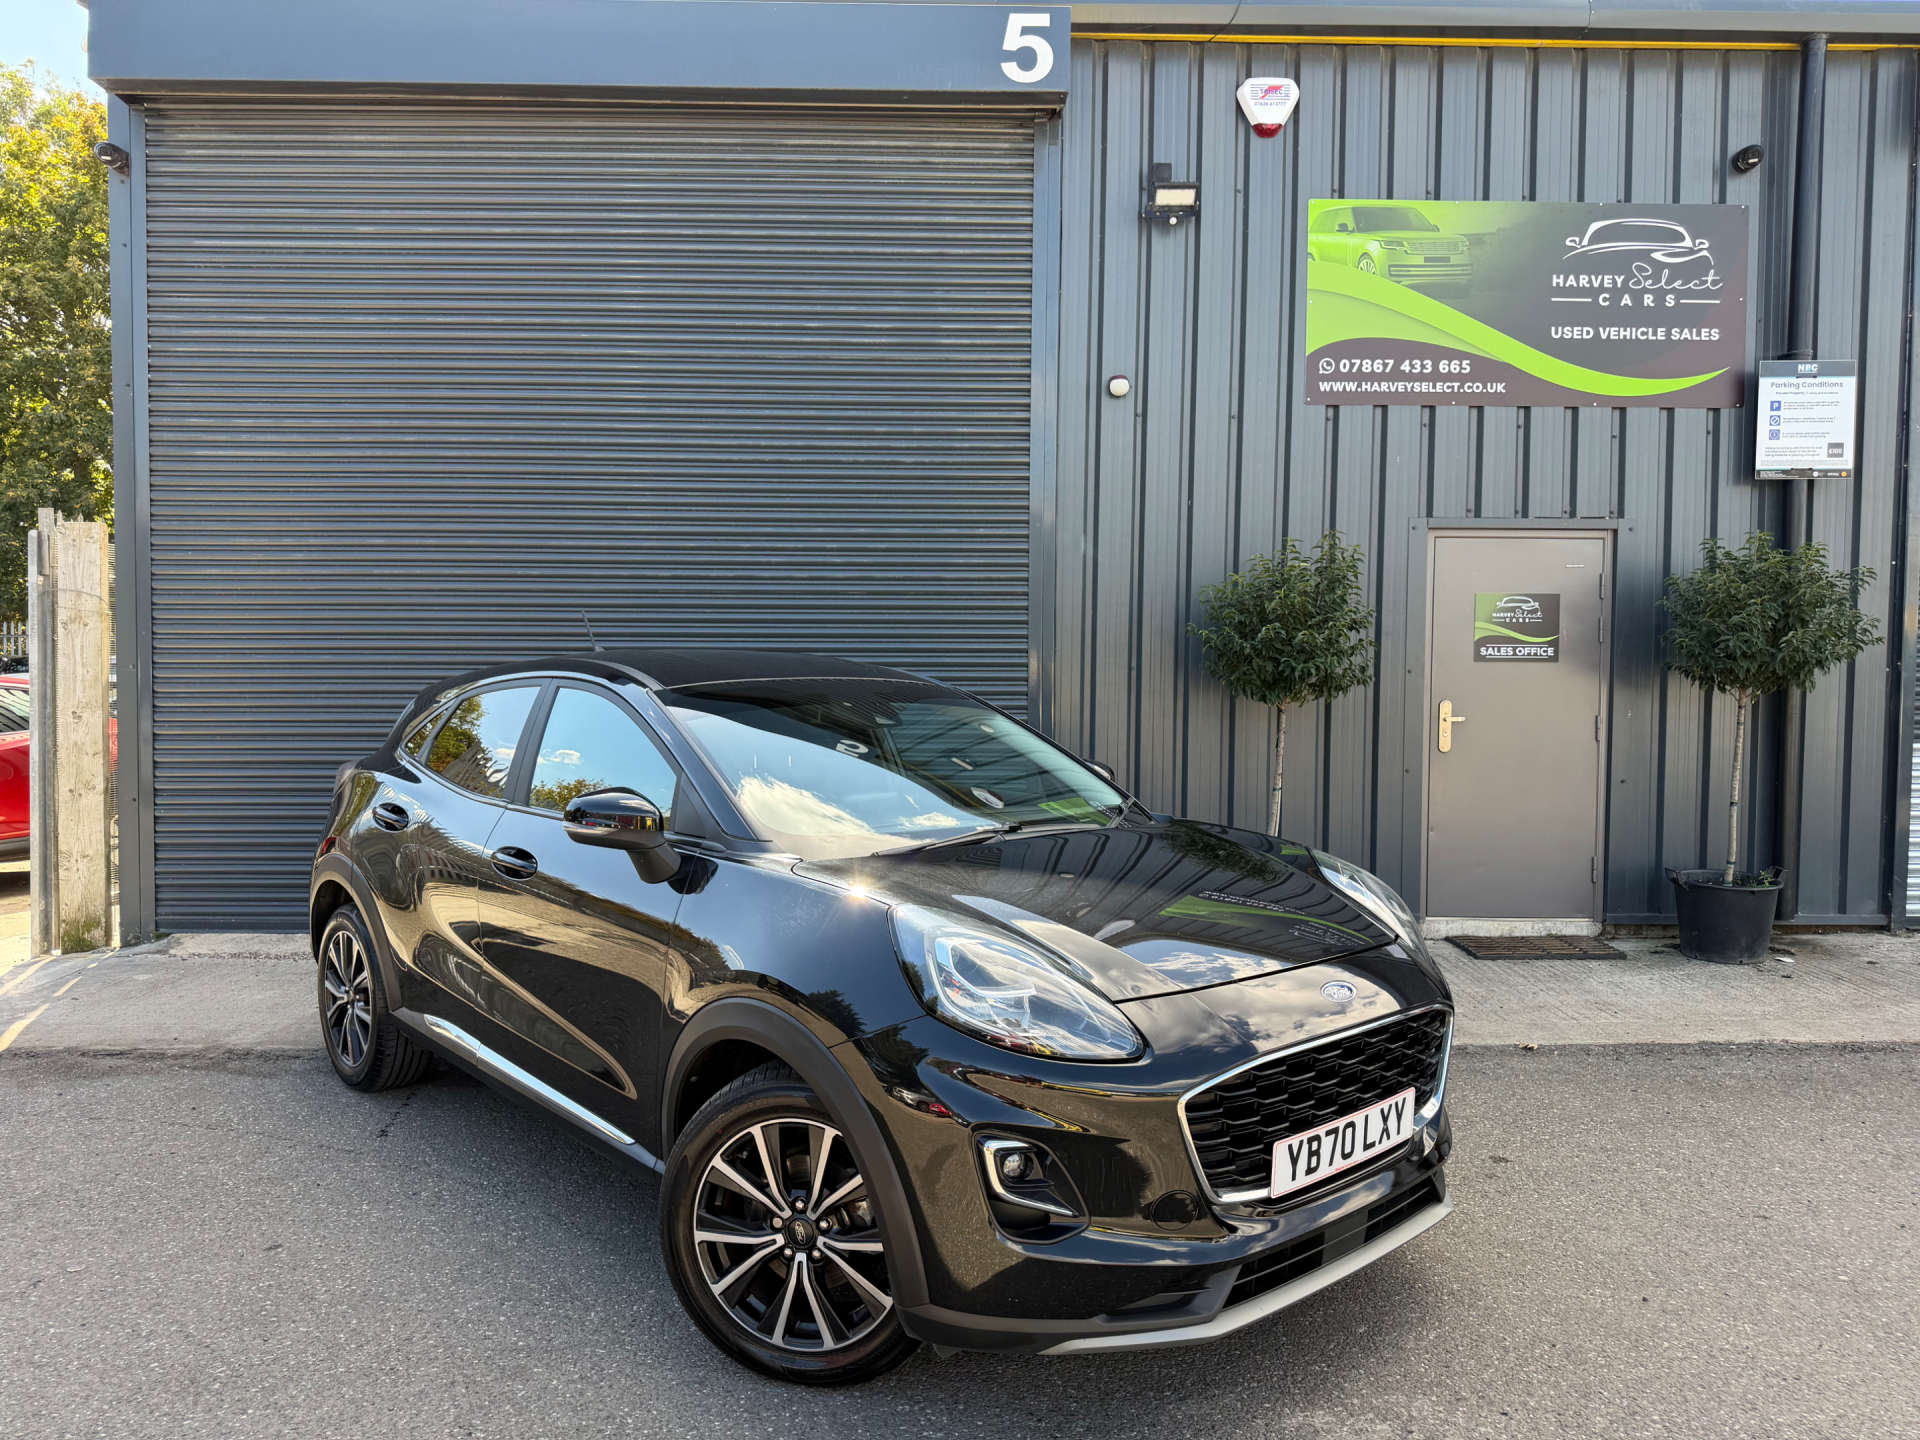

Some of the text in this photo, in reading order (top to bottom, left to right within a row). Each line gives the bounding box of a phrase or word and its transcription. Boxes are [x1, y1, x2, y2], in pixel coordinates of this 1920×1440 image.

[1000, 13, 1054, 84] 5
[1552, 262, 1723, 290] HARVEY Select
[1598, 293, 1676, 307] CARS
[1551, 326, 1720, 341] USED VEHICLE SALES
[1339, 359, 1471, 373] 07867 433 665
[1319, 381, 1506, 393] WWW.HARVEYSELECT.CO.UK
[1770, 381, 1800, 389] Parking
[1480, 647, 1554, 656] SALES OFFICE
[1288, 1097, 1407, 1182] YB70 LXY
